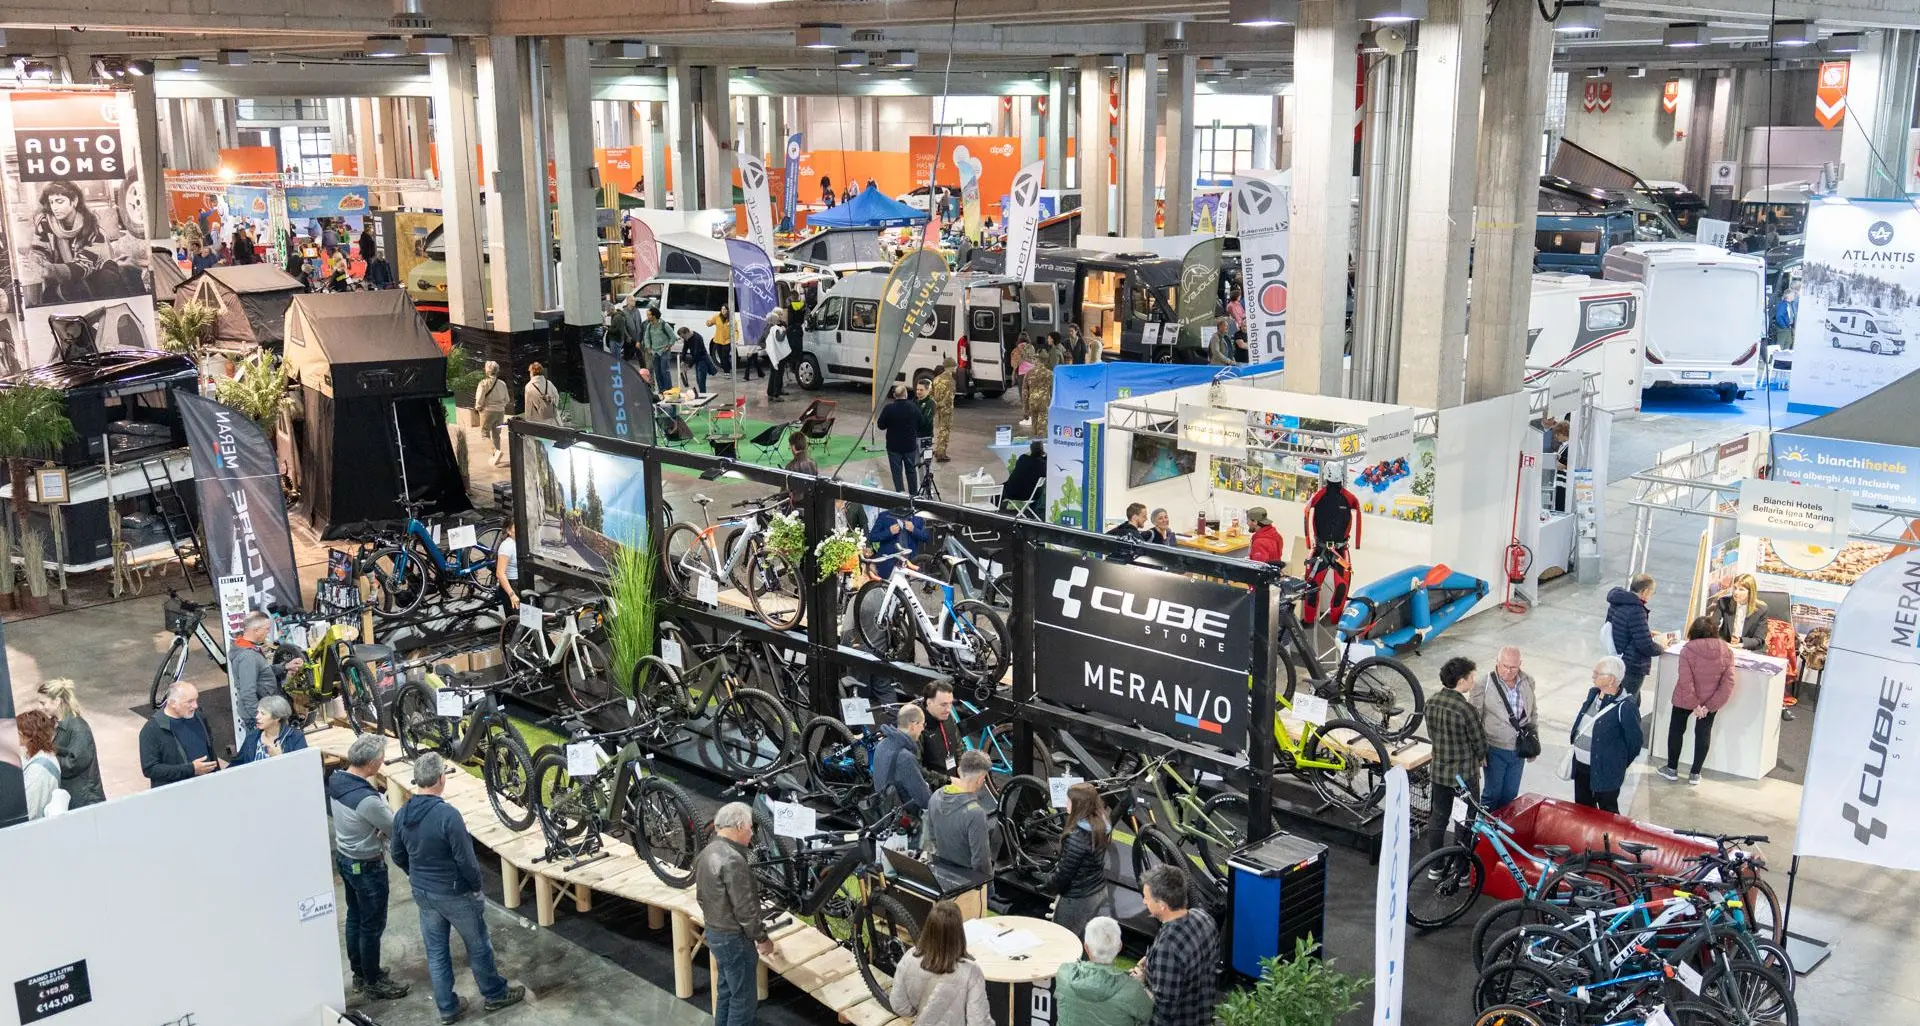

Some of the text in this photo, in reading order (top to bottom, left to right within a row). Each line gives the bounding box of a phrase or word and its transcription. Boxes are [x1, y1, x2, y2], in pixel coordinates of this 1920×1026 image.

[24, 134, 116, 155] AUTO
[27, 155, 117, 176] HOME
[1842, 249, 1915, 263] ATLANTIS
[902, 270, 941, 334] CELLULA
[1782, 469, 1801, 479] tuoi
[1802, 470, 1841, 484] alberghi
[1858, 477, 1900, 491] Inclusive
[1763, 496, 1823, 512] Bianchi Hotels
[1861, 489, 1917, 505] Romagnola
[1753, 504, 1784, 515] Bellaria
[1805, 512, 1834, 523] Marina
[1768, 516, 1815, 530] Cesenatico
[1090, 585, 1230, 639] CUBE
[1890, 560, 1920, 648] MERAN
[1144, 625, 1225, 652] STORE
[1084, 660, 1232, 725] MERAN/O
[1892, 684, 1913, 760] STORE
[1859, 676, 1903, 807] CUBE
[1501, 853, 1528, 888] CUBE
[314, 902, 333, 913] AREA
[28, 966, 74, 986] ZAINO 21 LITRI
[36, 993, 75, 1013] €143,00
[1603, 991, 1636, 1023] CUBE
